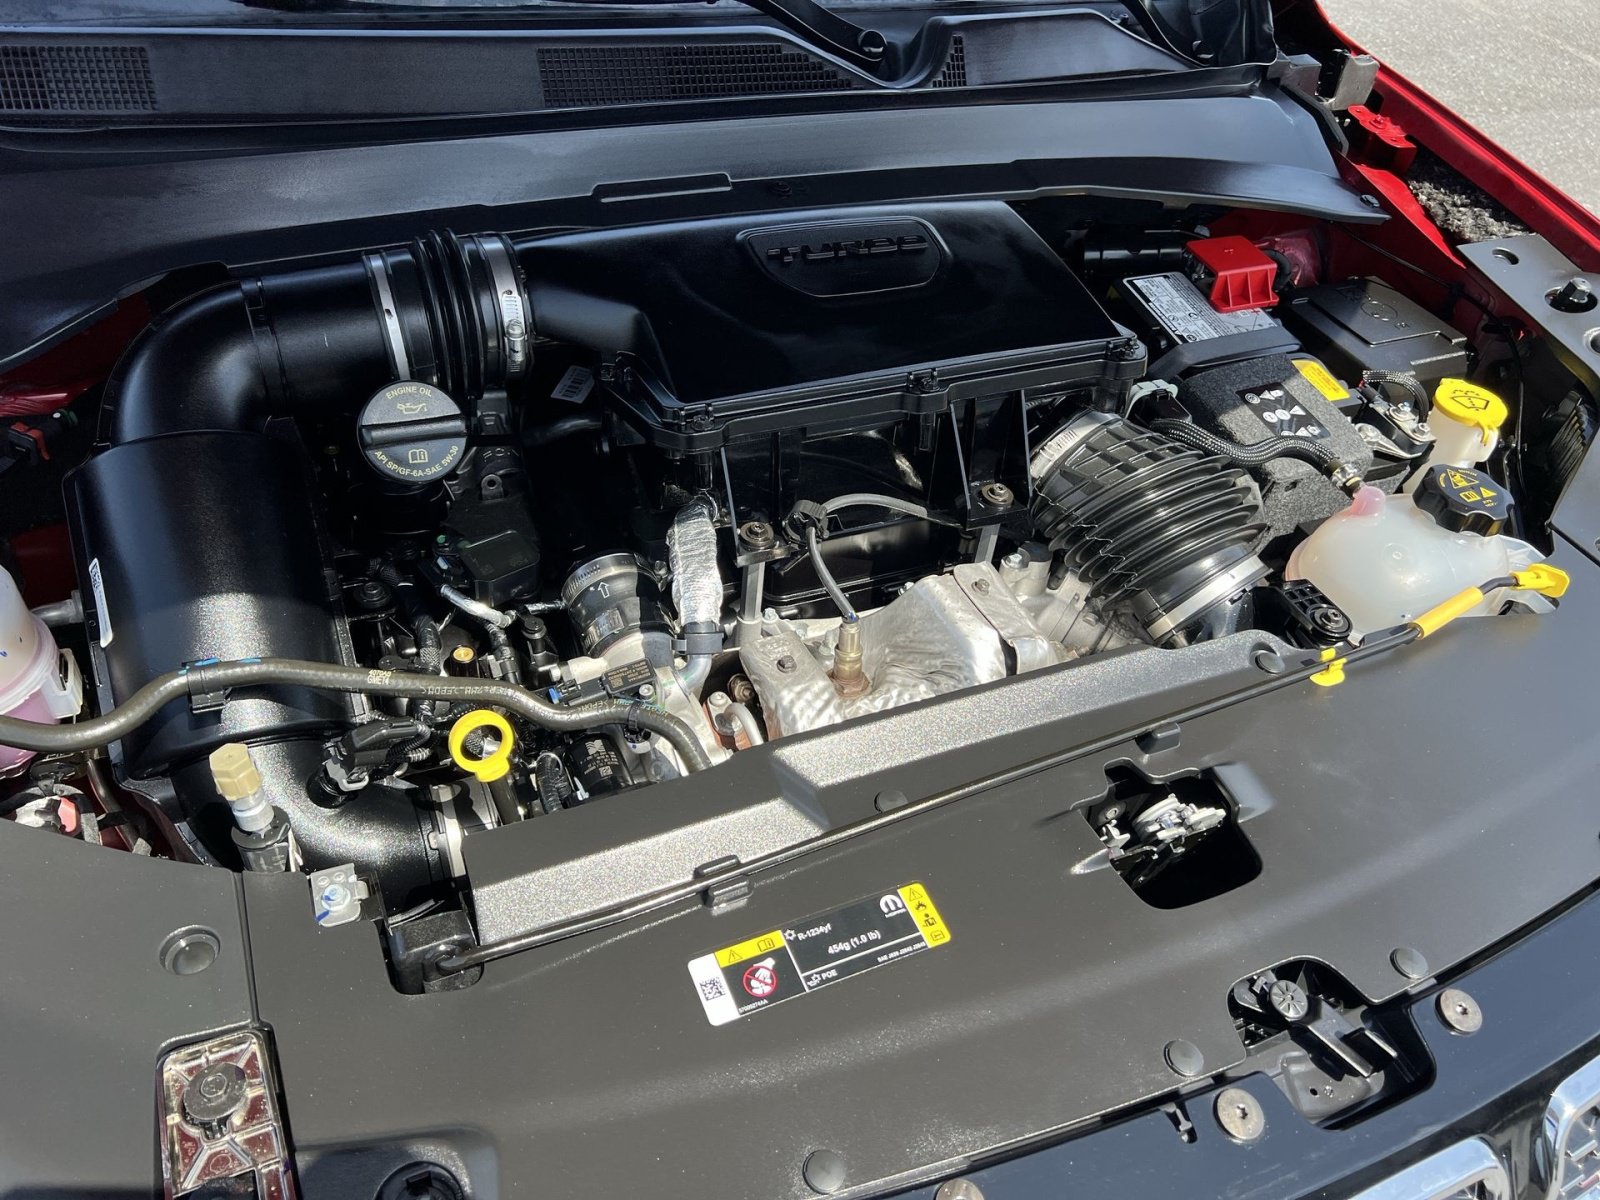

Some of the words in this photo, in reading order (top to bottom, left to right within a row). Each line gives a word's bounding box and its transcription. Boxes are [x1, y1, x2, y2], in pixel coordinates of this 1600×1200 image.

[767, 234, 928, 263] TURBO
[386, 386, 417, 400] ENGINE
[419, 386, 433, 398] OIL
[374, 450, 388, 464] API
[441, 445, 459, 467] 5W-30
[797, 922, 832, 941] R-1234yf
[827, 941, 851, 955] 454g
[850, 933, 868, 948] (1.0
[868, 929, 882, 941] lb)
[821, 968, 838, 980] POE
